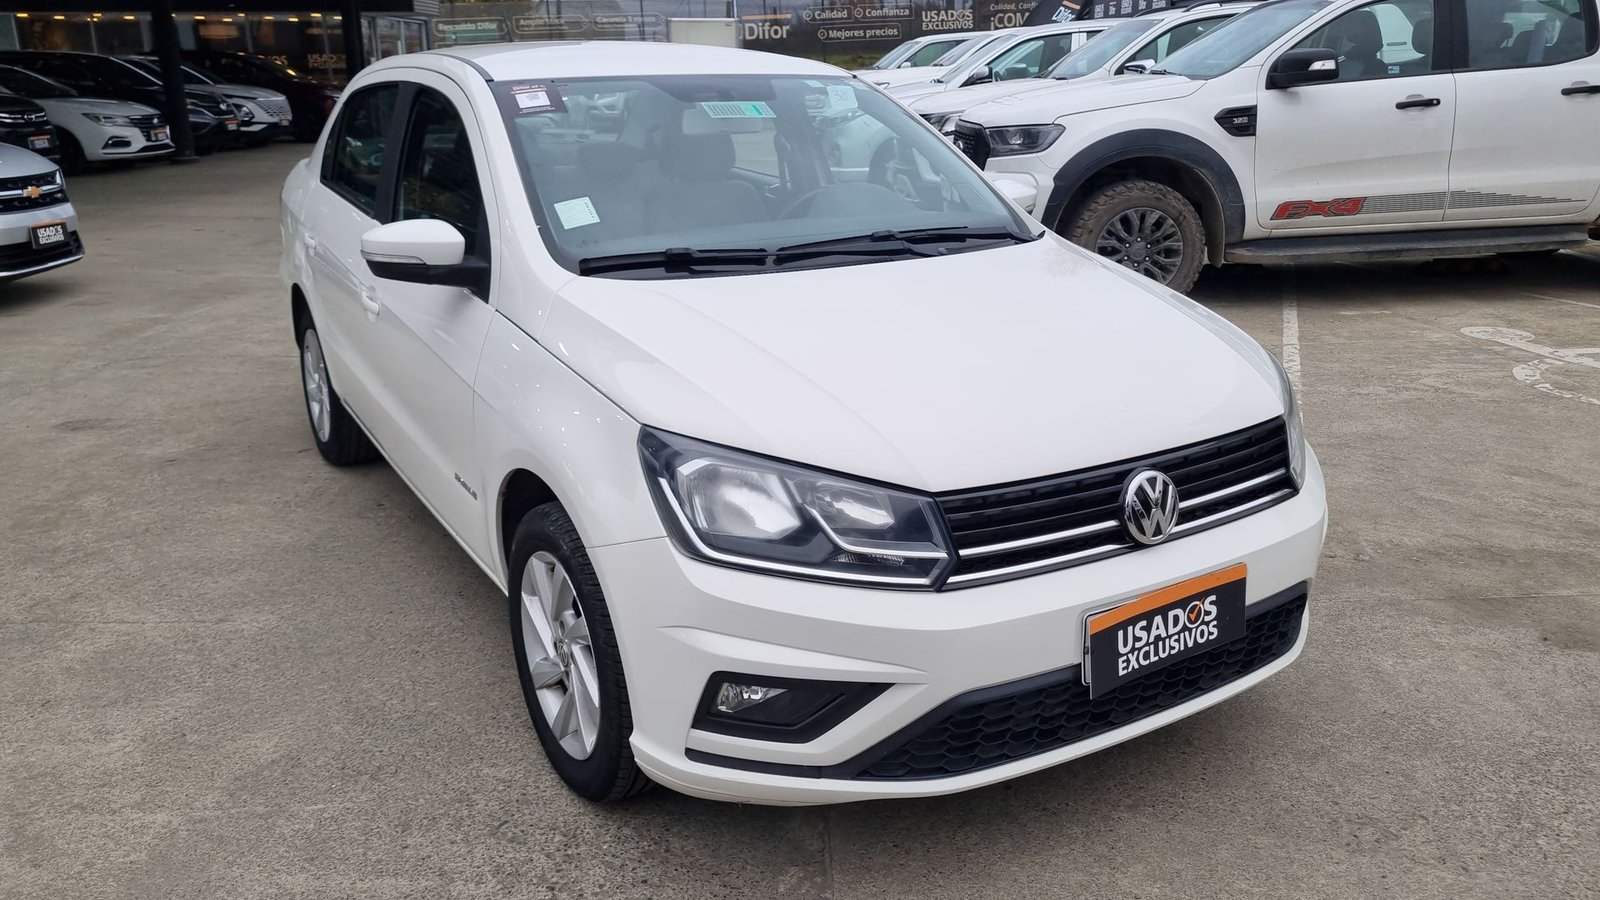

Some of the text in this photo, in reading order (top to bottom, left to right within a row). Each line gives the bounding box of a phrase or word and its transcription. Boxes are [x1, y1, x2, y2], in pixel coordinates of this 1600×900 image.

[815, 9, 848, 19] Calidad
[865, 8, 910, 17] Confianza
[922, 9, 973, 22] USADOS
[744, 22, 790, 40] Difor
[922, 20, 974, 30] EXCLUSIVOS
[828, 27, 898, 39] Mejores precios
[1269, 197, 1367, 220] FX4
[37, 225, 63, 238] USADOS
[1117, 594, 1218, 655] USADOS
[1118, 621, 1218, 677] EXCLUSIVOS
